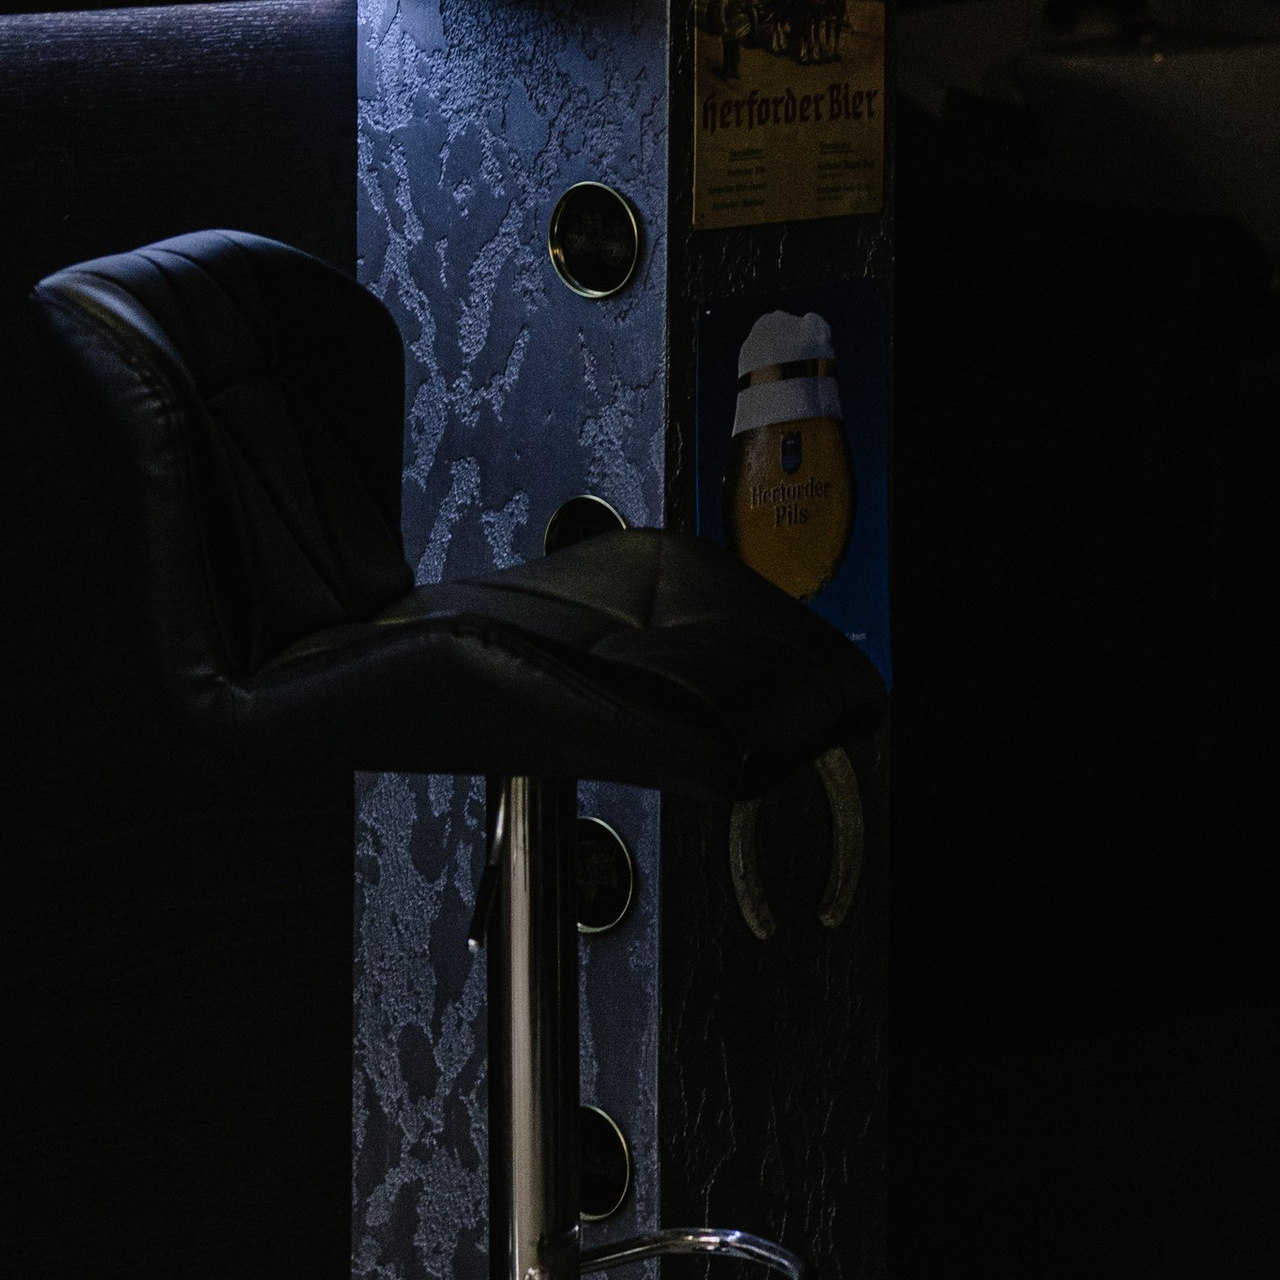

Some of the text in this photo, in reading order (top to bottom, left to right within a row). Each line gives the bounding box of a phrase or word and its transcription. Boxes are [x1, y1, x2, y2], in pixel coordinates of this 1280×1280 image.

[702, 83, 878, 135] Herforder Bier
[751, 479, 829, 509] Herforder
[776, 504, 808, 526] Pils
